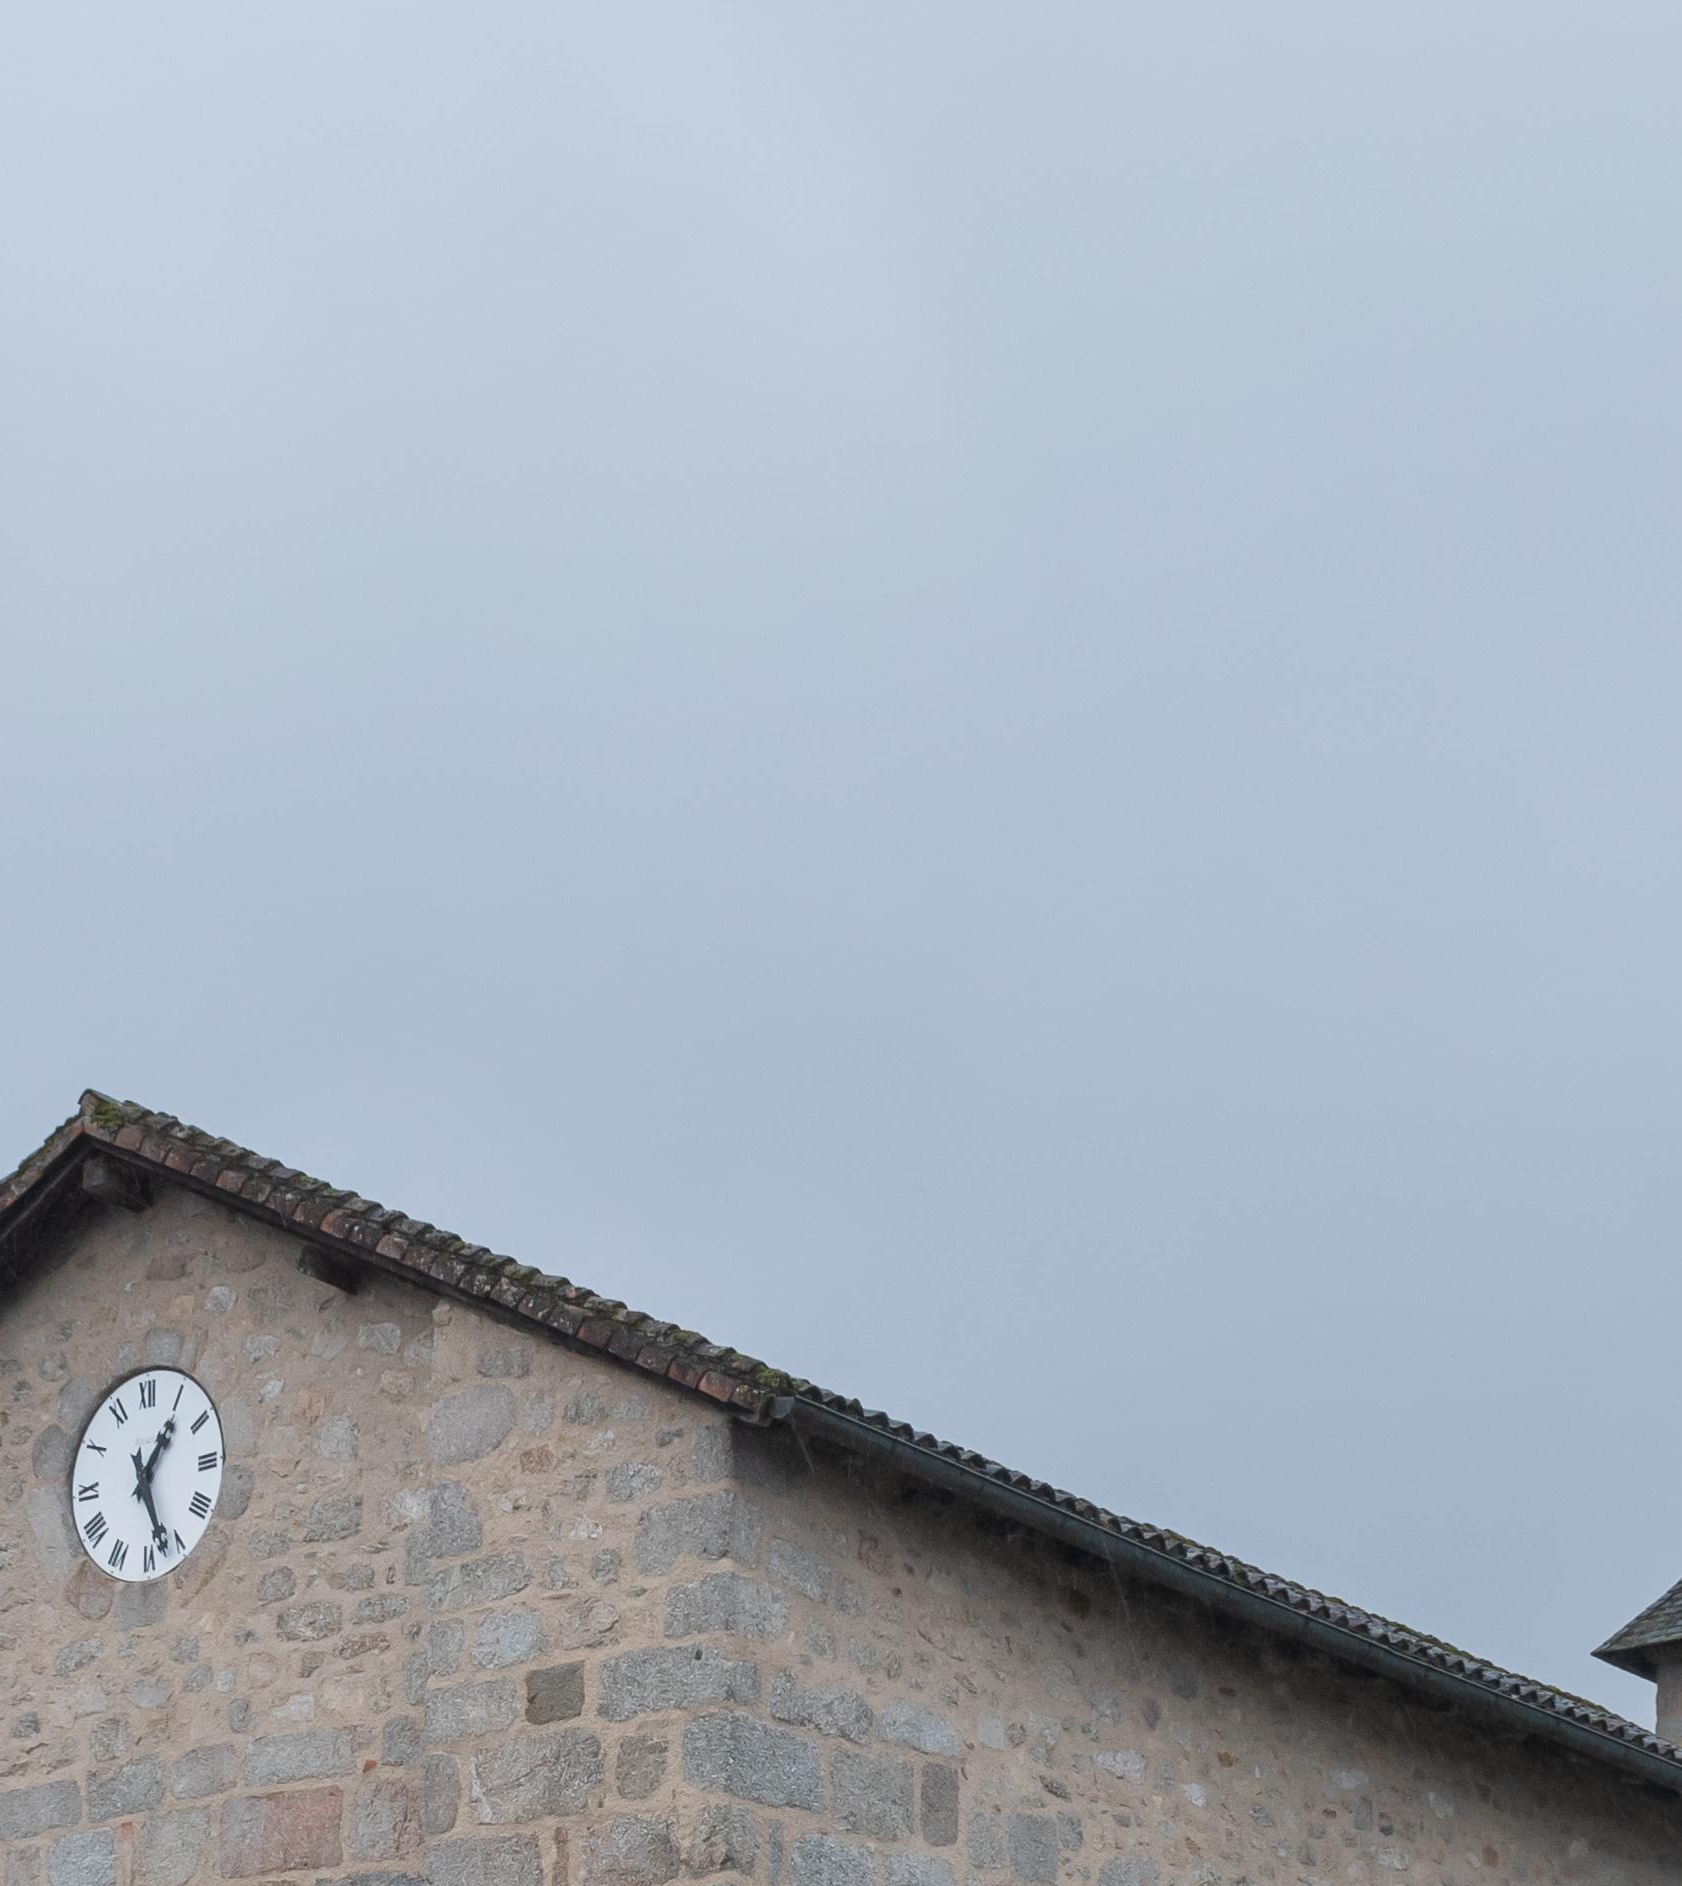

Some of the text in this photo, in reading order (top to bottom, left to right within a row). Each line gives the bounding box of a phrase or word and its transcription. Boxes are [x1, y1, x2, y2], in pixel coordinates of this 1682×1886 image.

[139, 1379, 156, 1410] XII
[109, 1398, 128, 1428] XI
[190, 1410, 210, 1434] II
[87, 1439, 107, 1458] X
[198, 1451, 217, 1472] III
[78, 1482, 99, 1502] IX
[189, 1491, 212, 1520] IIII
